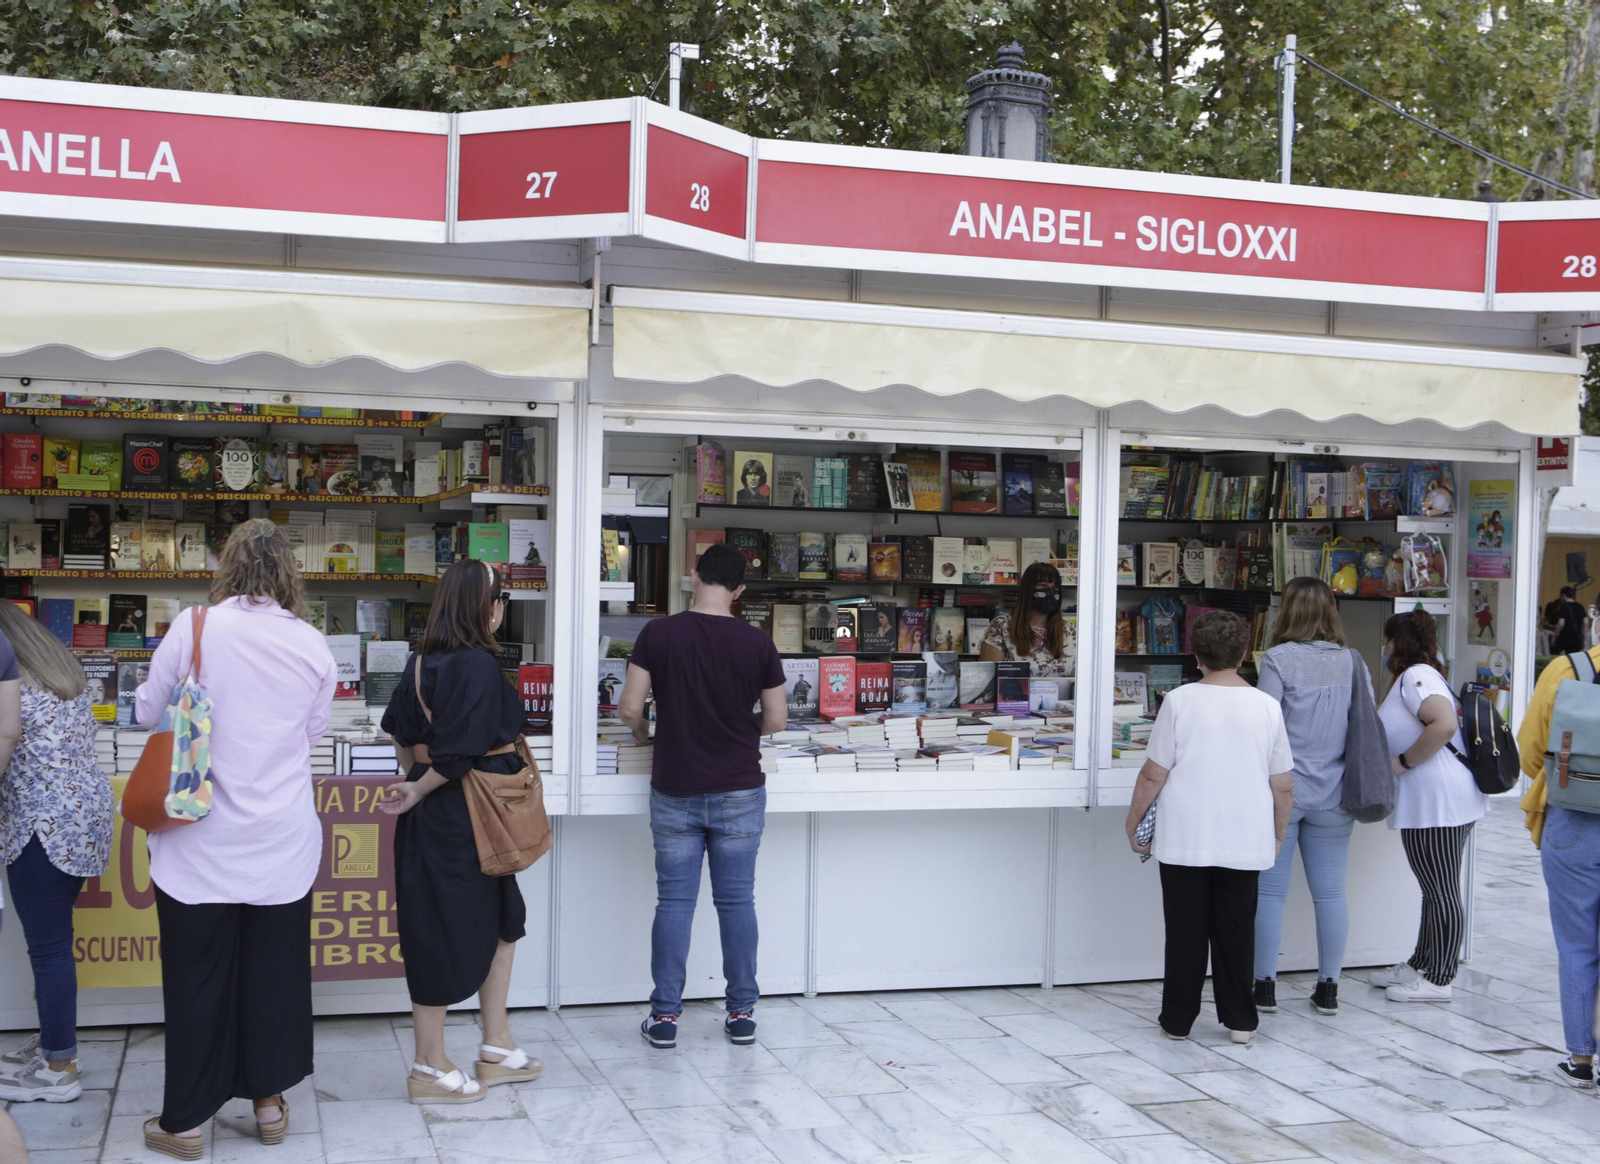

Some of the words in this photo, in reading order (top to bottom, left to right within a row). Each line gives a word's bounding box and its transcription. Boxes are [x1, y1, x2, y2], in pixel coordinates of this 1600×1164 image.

[525, 170, 559, 199] 27
[689, 182, 711, 212] 28
[949, 200, 1104, 247] ANABEL
[1114, 232, 1126, 240] -
[1135, 214, 1297, 262] SIGLOXXI
[1561, 255, 1597, 278] 28
[26, 408, 85, 417] DESCUENTO
[124, 412, 179, 420] DESCUENTO
[218, 414, 273, 422] DESCUENTO
[225, 452, 249, 462] 100
[816, 461, 844, 469] HISTORIA
[514, 486, 548, 494] DESCU
[378, 538, 404, 546] AHORA
[1186, 551, 1204, 560] 100
[777, 621, 800, 629] Sapiens
[810, 627, 835, 640] DUNE
[524, 682, 554, 695] REINA
[860, 677, 889, 689] REINA
[1115, 677, 1132, 687] Esta
[861, 691, 889, 703] ROJA
[524, 699, 554, 712] ROJA
[312, 890, 397, 912] ERI
[310, 916, 400, 940] DEL
[74, 936, 162, 963] SCUENT
